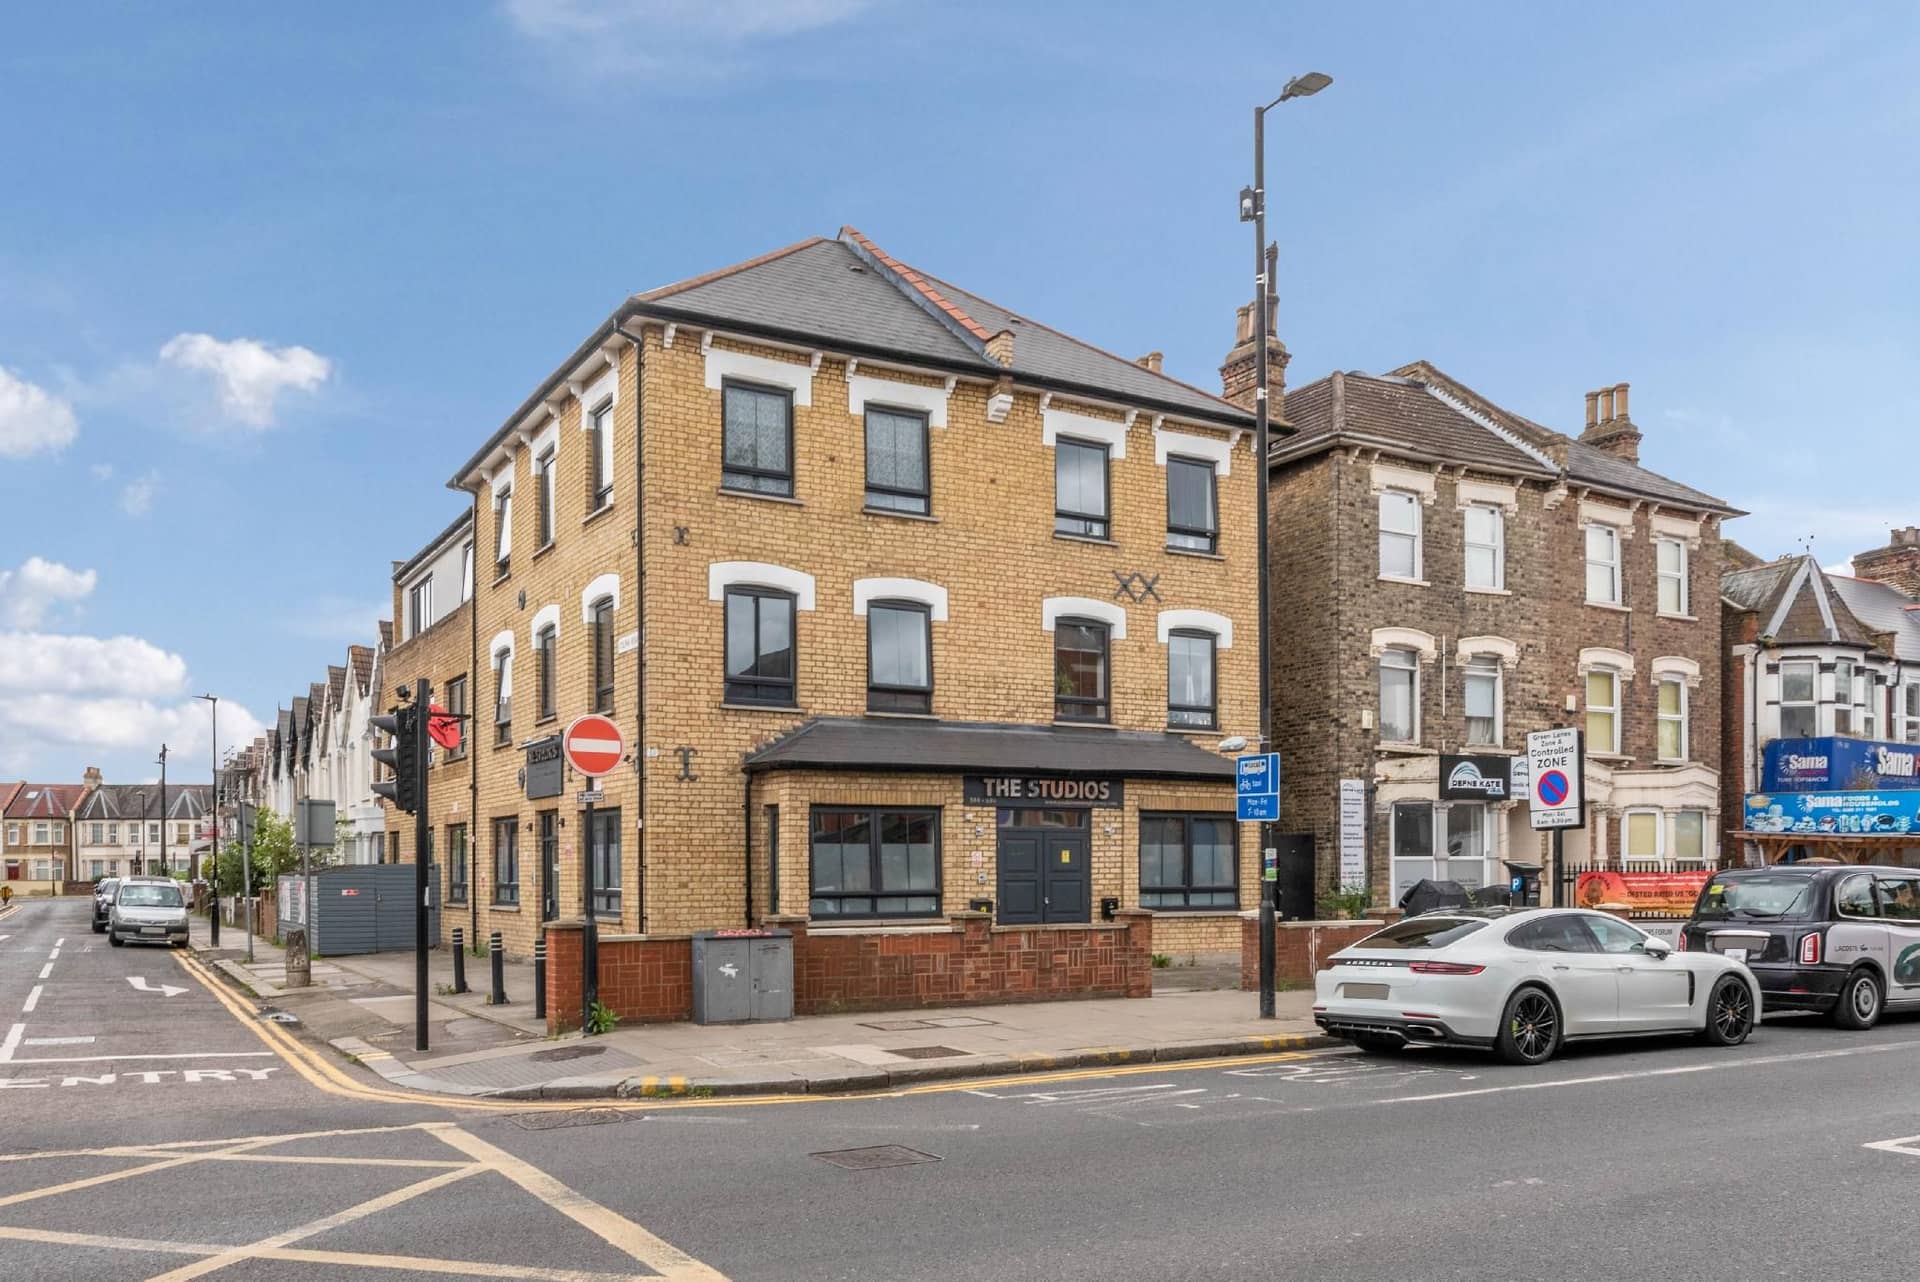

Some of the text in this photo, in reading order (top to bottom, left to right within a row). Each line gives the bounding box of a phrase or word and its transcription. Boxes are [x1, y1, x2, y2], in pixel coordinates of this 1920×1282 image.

[1530, 745, 1574, 757] Controlled
[1537, 756, 1567, 768] ZONE
[1789, 754, 1828, 769] Sama
[1877, 746, 1914, 776] Sama
[984, 778, 1110, 799] THE STUDIOS
[1806, 794, 1842, 808] Sama
[1512, 877, 1519, 889] P
[1834, 944, 1858, 952] LACOSTE
[0, 1067, 280, 1088] ENTRY
